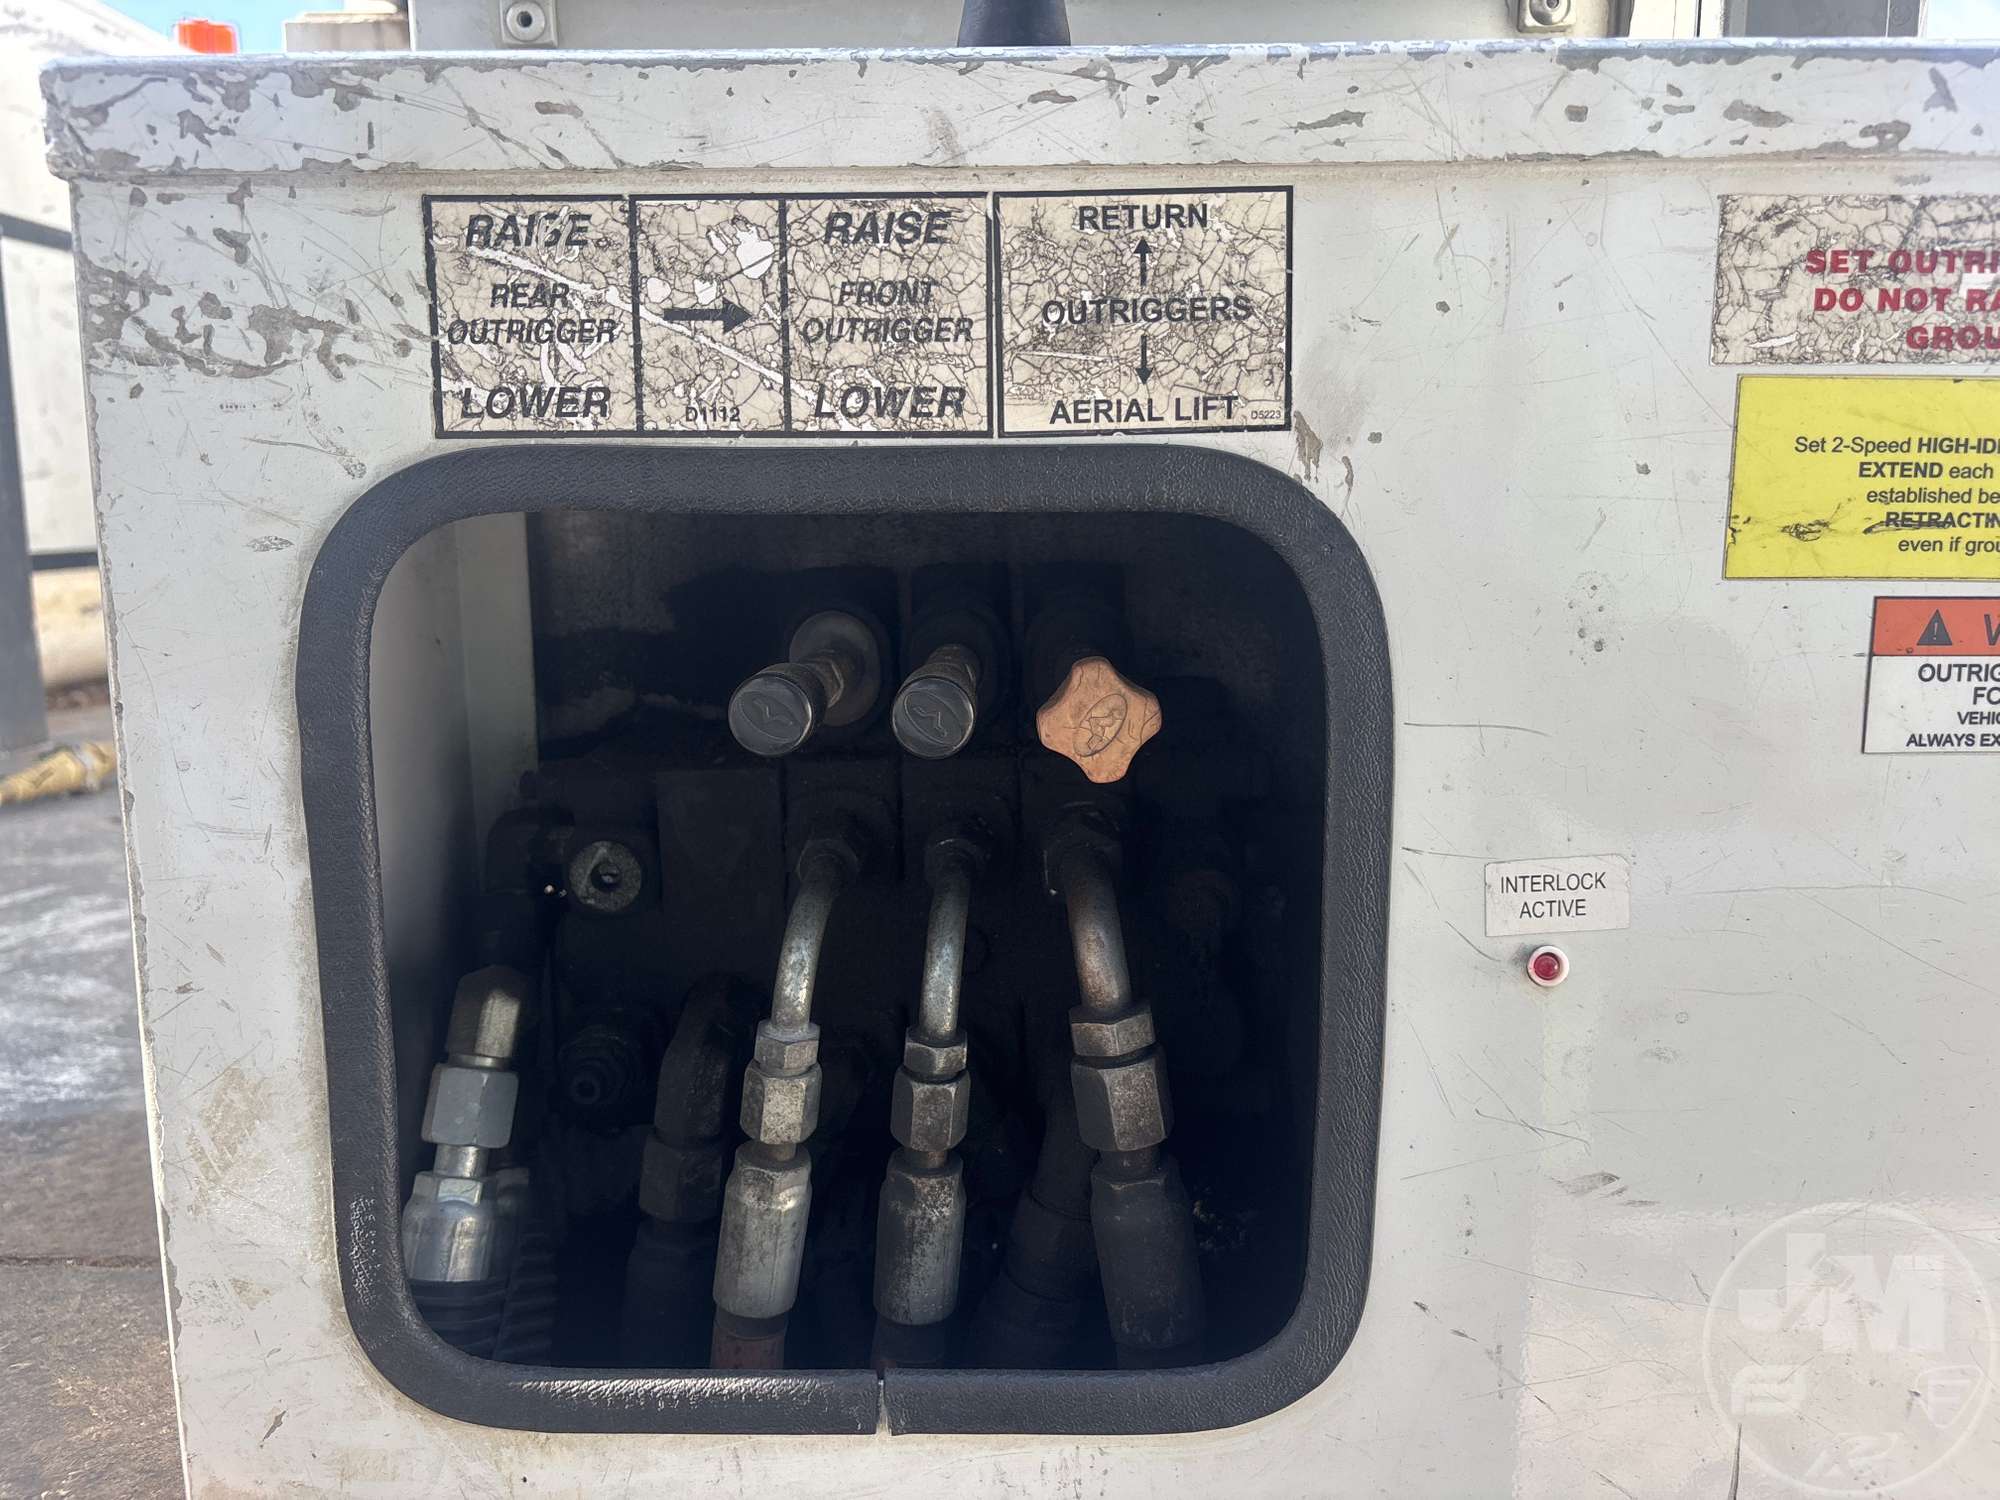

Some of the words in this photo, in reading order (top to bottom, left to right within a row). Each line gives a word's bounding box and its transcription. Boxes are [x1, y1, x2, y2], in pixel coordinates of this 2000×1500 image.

[824, 210, 950, 245] RAISE
[1079, 204, 1208, 231] RETURN
[1805, 249, 1874, 274] SET
[490, 283, 570, 309] REAR
[838, 280, 937, 307] FRONT
[1814, 287, 1865, 313] DO
[1877, 287, 1952, 313] NOT
[1041, 297, 1252, 326] OUTRIGGERS
[447, 317, 617, 345] OUTRIGGER
[802, 316, 974, 343] OUTRIGGER
[461, 386, 611, 419] LOWER
[685, 405, 741, 422] D1112
[814, 384, 966, 419] LOWER
[1049, 398, 1164, 425] AERIAL
[1174, 395, 1239, 421] LIFT
[1250, 409, 1281, 420] D5223
[1794, 436, 1827, 454] Set
[1832, 436, 1911, 458] 2-Speed
[1858, 461, 1943, 479] EXTEND
[1949, 463, 1994, 480] each
[1866, 487, 1973, 504] established
[1898, 539, 1943, 553] even
[1949, 536, 1963, 553] if
[1906, 732, 1976, 748] ALWAYS
[1500, 871, 1607, 894] INTERLOCK
[1519, 898, 1587, 919] ACTIVE
